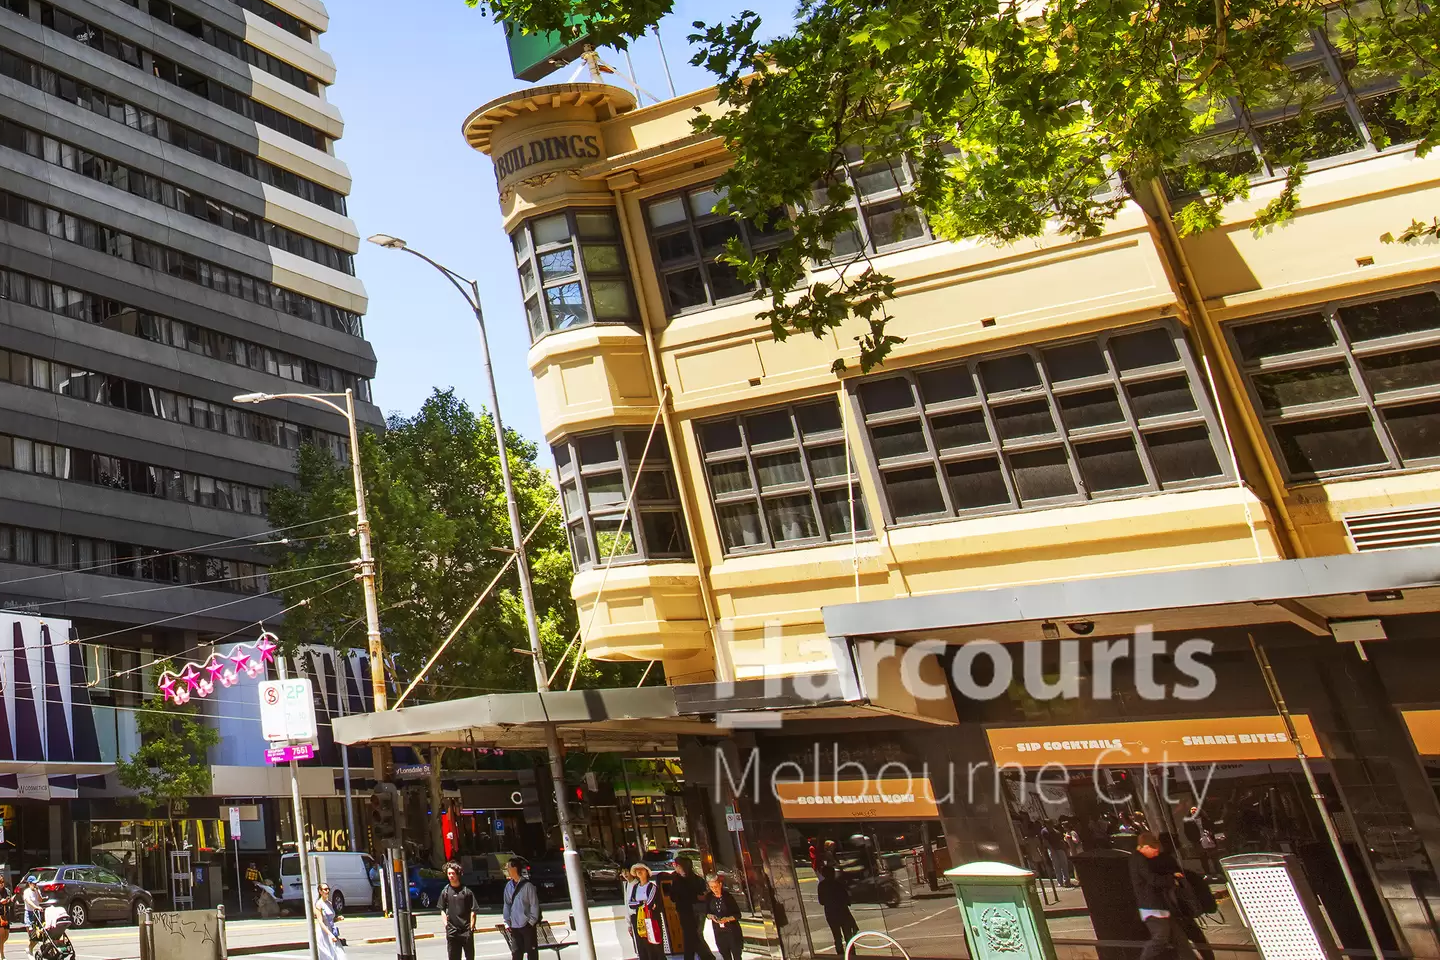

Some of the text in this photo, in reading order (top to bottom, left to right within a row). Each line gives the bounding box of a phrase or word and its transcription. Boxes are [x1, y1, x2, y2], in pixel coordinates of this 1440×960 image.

[496, 135, 600, 181] BUILDINGS
[286, 684, 304, 699] 2P
[1016, 739, 1123, 752] SIP COCKTAILS
[1182, 732, 1288, 746] SHARE BITES
[400, 766, 422, 774] Lonsdale
[797, 793, 915, 805] BOOK ONLINE NOW
